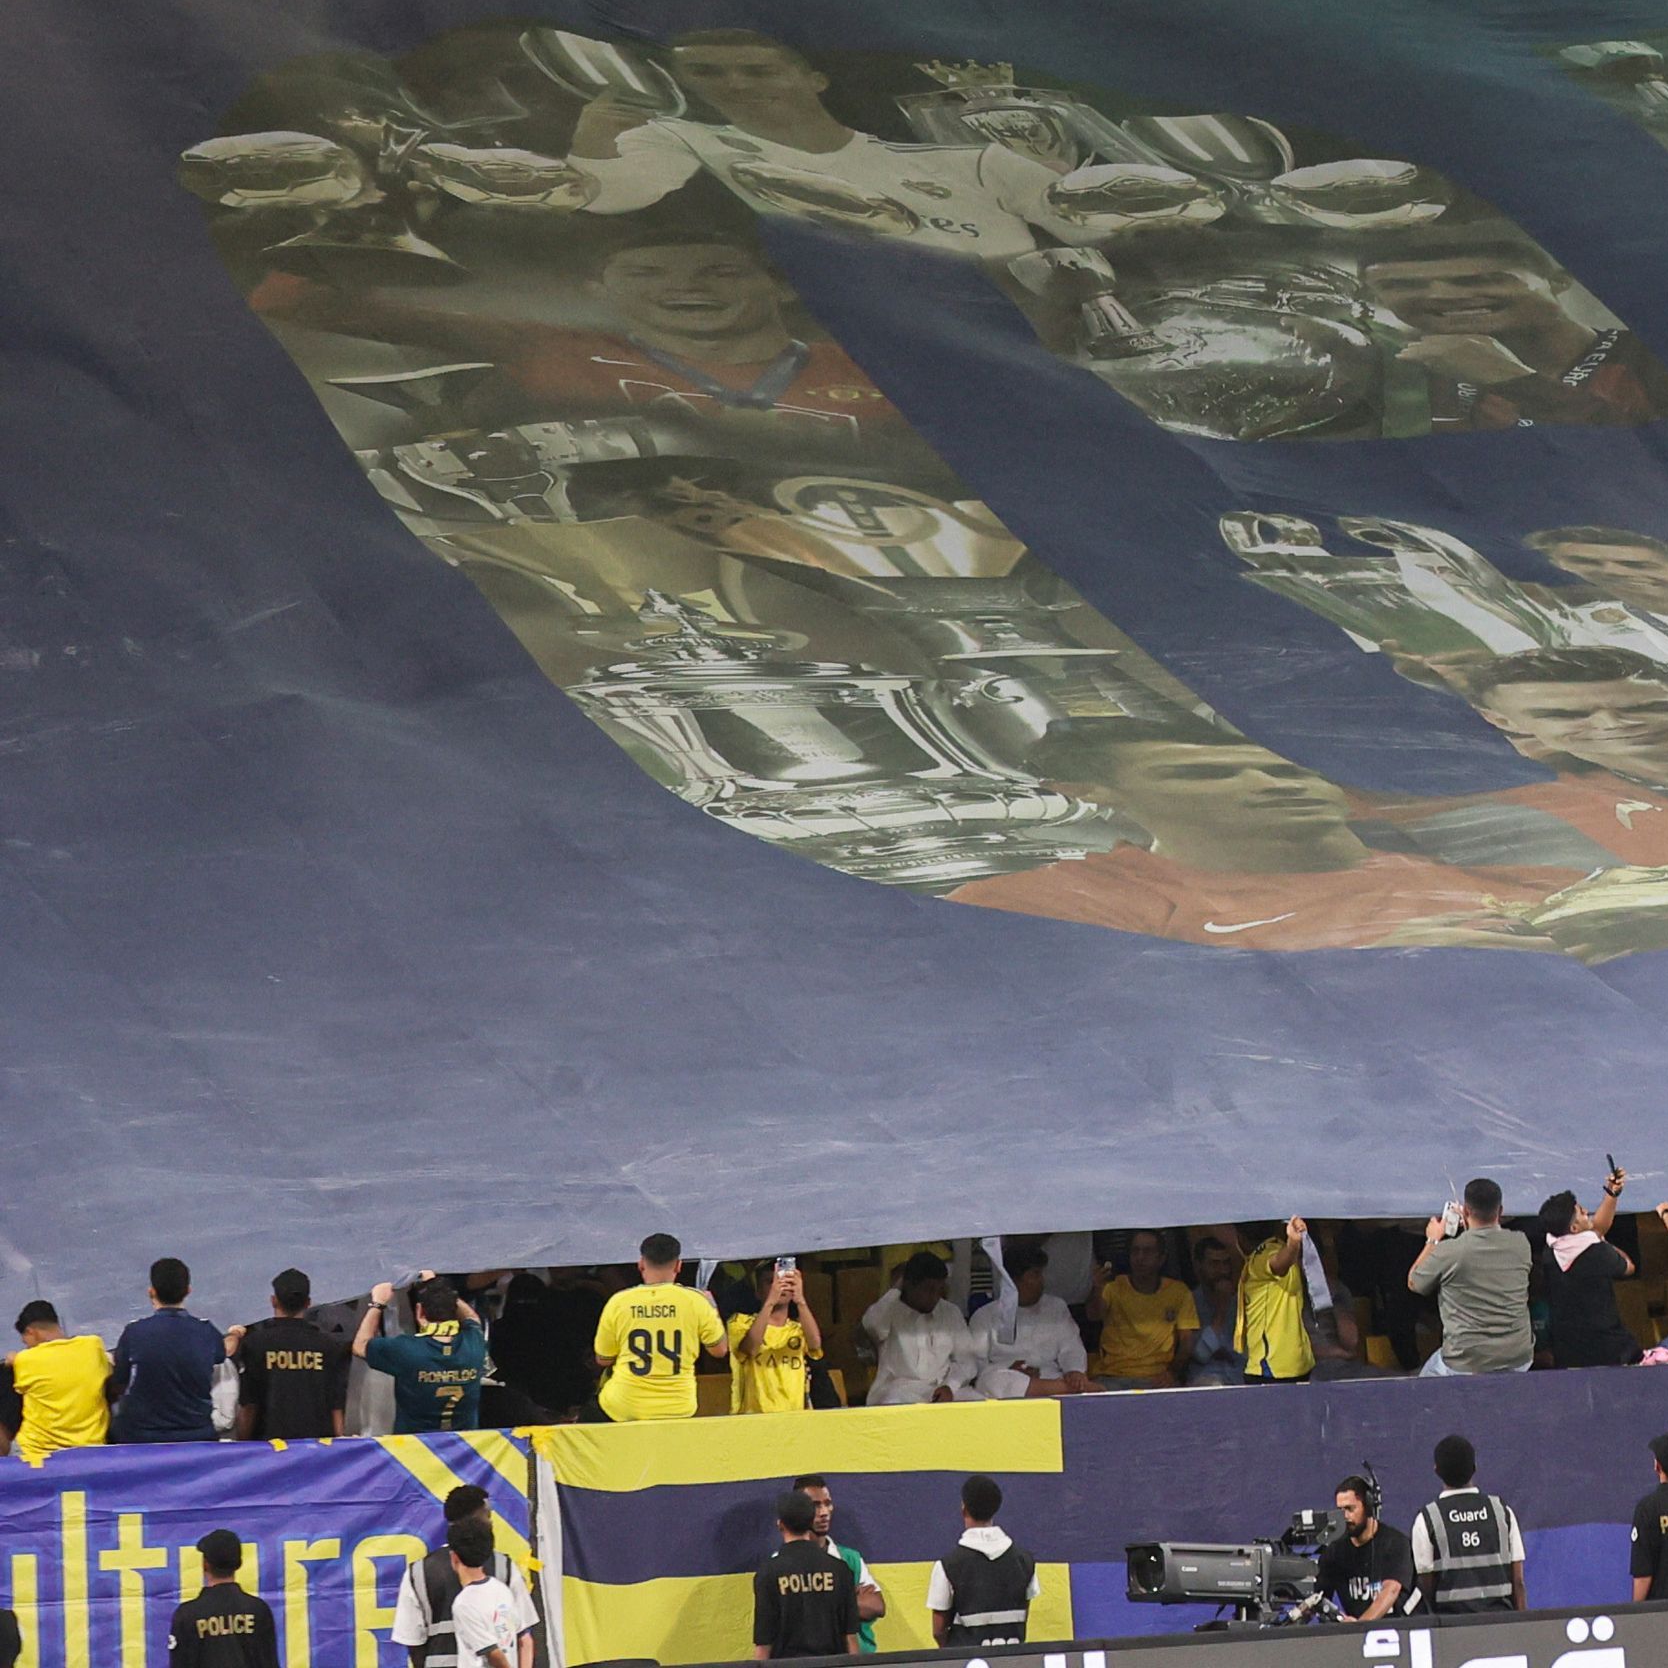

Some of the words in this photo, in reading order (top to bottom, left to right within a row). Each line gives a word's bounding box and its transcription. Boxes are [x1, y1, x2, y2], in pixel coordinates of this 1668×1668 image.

[630, 1305, 677, 1319] TALISCA
[265, 1350, 324, 1371] POLICE
[628, 1329, 682, 1376] 94
[1449, 1506, 1488, 1523] Guard
[1461, 1531, 1480, 1548] 86
[778, 1572, 835, 1595] POLICE
[197, 1614, 255, 1638] POLICE
